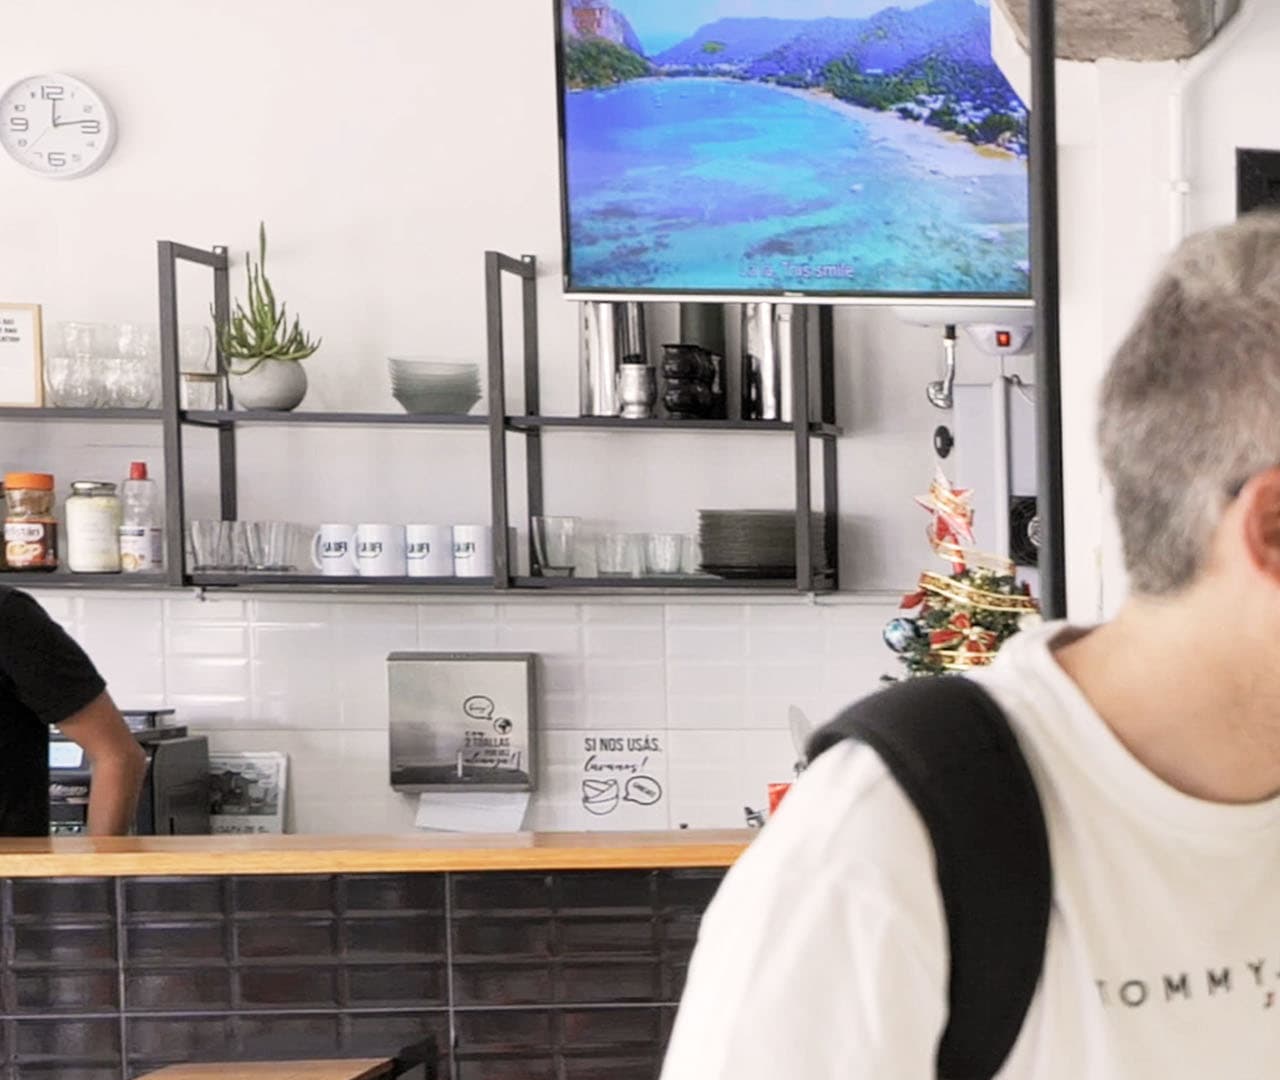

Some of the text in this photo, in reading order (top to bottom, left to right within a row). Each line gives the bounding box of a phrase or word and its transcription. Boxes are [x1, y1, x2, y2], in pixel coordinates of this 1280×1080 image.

[41, 85, 64, 100] 12
[10, 117, 28, 132] 9
[81, 119, 100, 134] 3
[47, 152, 66, 167] 6
[584, 738, 596, 752] SI
[600, 738, 624, 752] NOS
[1096, 956, 1265, 1007] TOMMY
